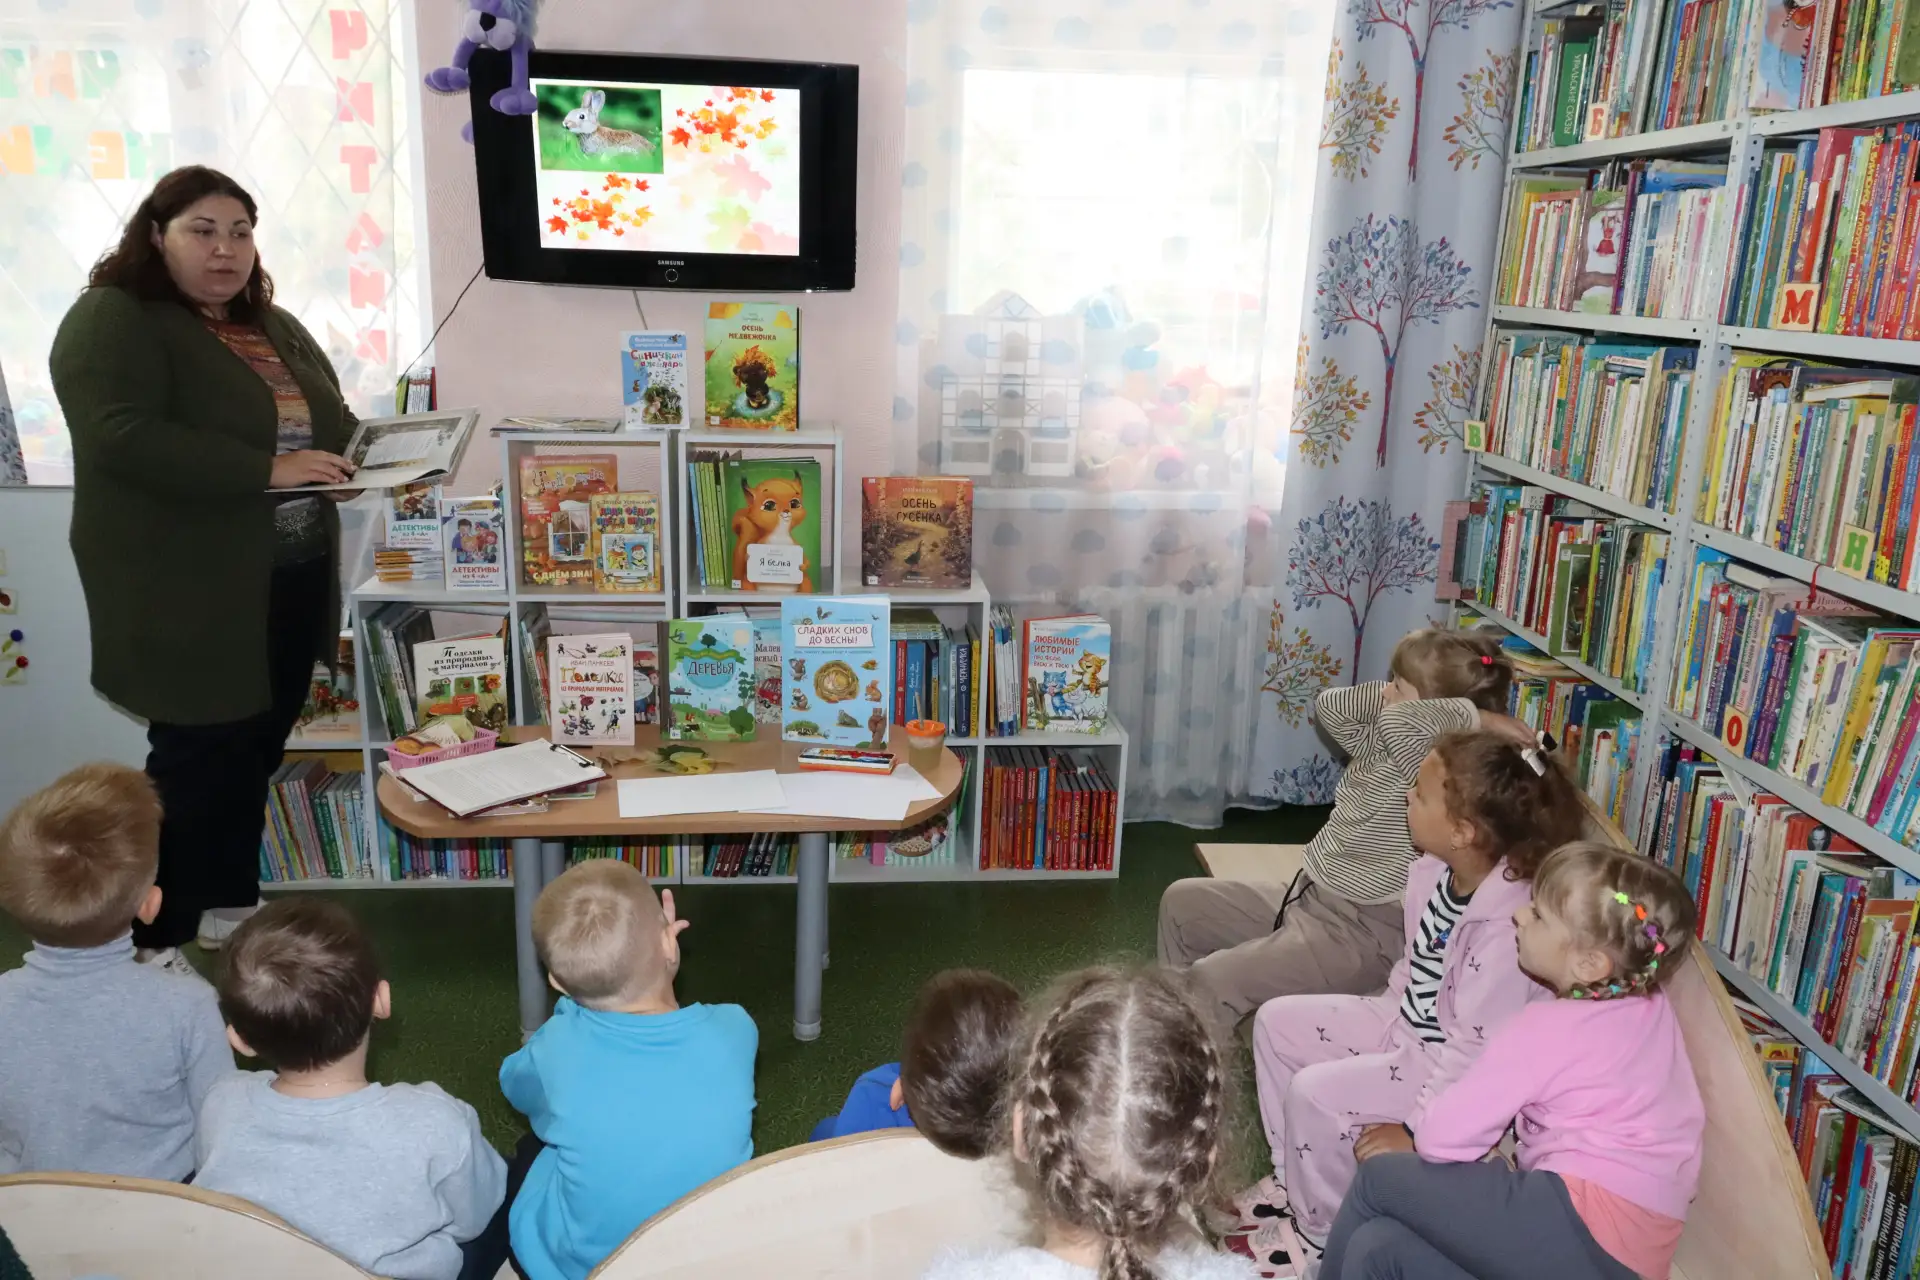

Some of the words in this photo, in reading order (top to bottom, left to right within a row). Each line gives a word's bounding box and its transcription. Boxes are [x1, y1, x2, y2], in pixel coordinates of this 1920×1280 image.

[1567, 53, 1582, 102] УРАЛЬСКИЕ
[1563, 103, 1574, 134] СКАЗЫ
[1785, 289, 1814, 325] М
[741, 324, 764, 332] ОСЕНЬ
[728, 332, 777, 341] МЕДВЕЖОНКА
[630, 349, 683, 360] Синичкин
[1468, 423, 1482, 449] В
[901, 498, 937, 509] ОСЕНЬ
[896, 511, 942, 523] ГУСЁНКА
[391, 524, 439, 532] ДЕТЕКТИВЫ
[1846, 532, 1868, 568] Н
[760, 557, 765, 566] Я
[767, 558, 791, 567] белка
[533, 571, 539, 579] С
[540, 570, 570, 580] ДНЁМ
[797, 626, 841, 636] СЛАДКИХ
[843, 626, 869, 635] СНОВ
[809, 636, 822, 646] ДО
[824, 635, 858, 645] ВЕСНЫ!
[1033, 635, 1080, 646] ЛЮБИМЫЕ
[443, 646, 483, 657] Поделки
[1034, 645, 1075, 655] ИСТОРИИ
[446, 656, 494, 664] природных
[440, 662, 488, 670] материалов
[1726, 716, 1742, 747] О
[1878, 1191, 1896, 1248] ПРИШВИН
[1889, 1204, 1908, 1263] ПРИШВИН
